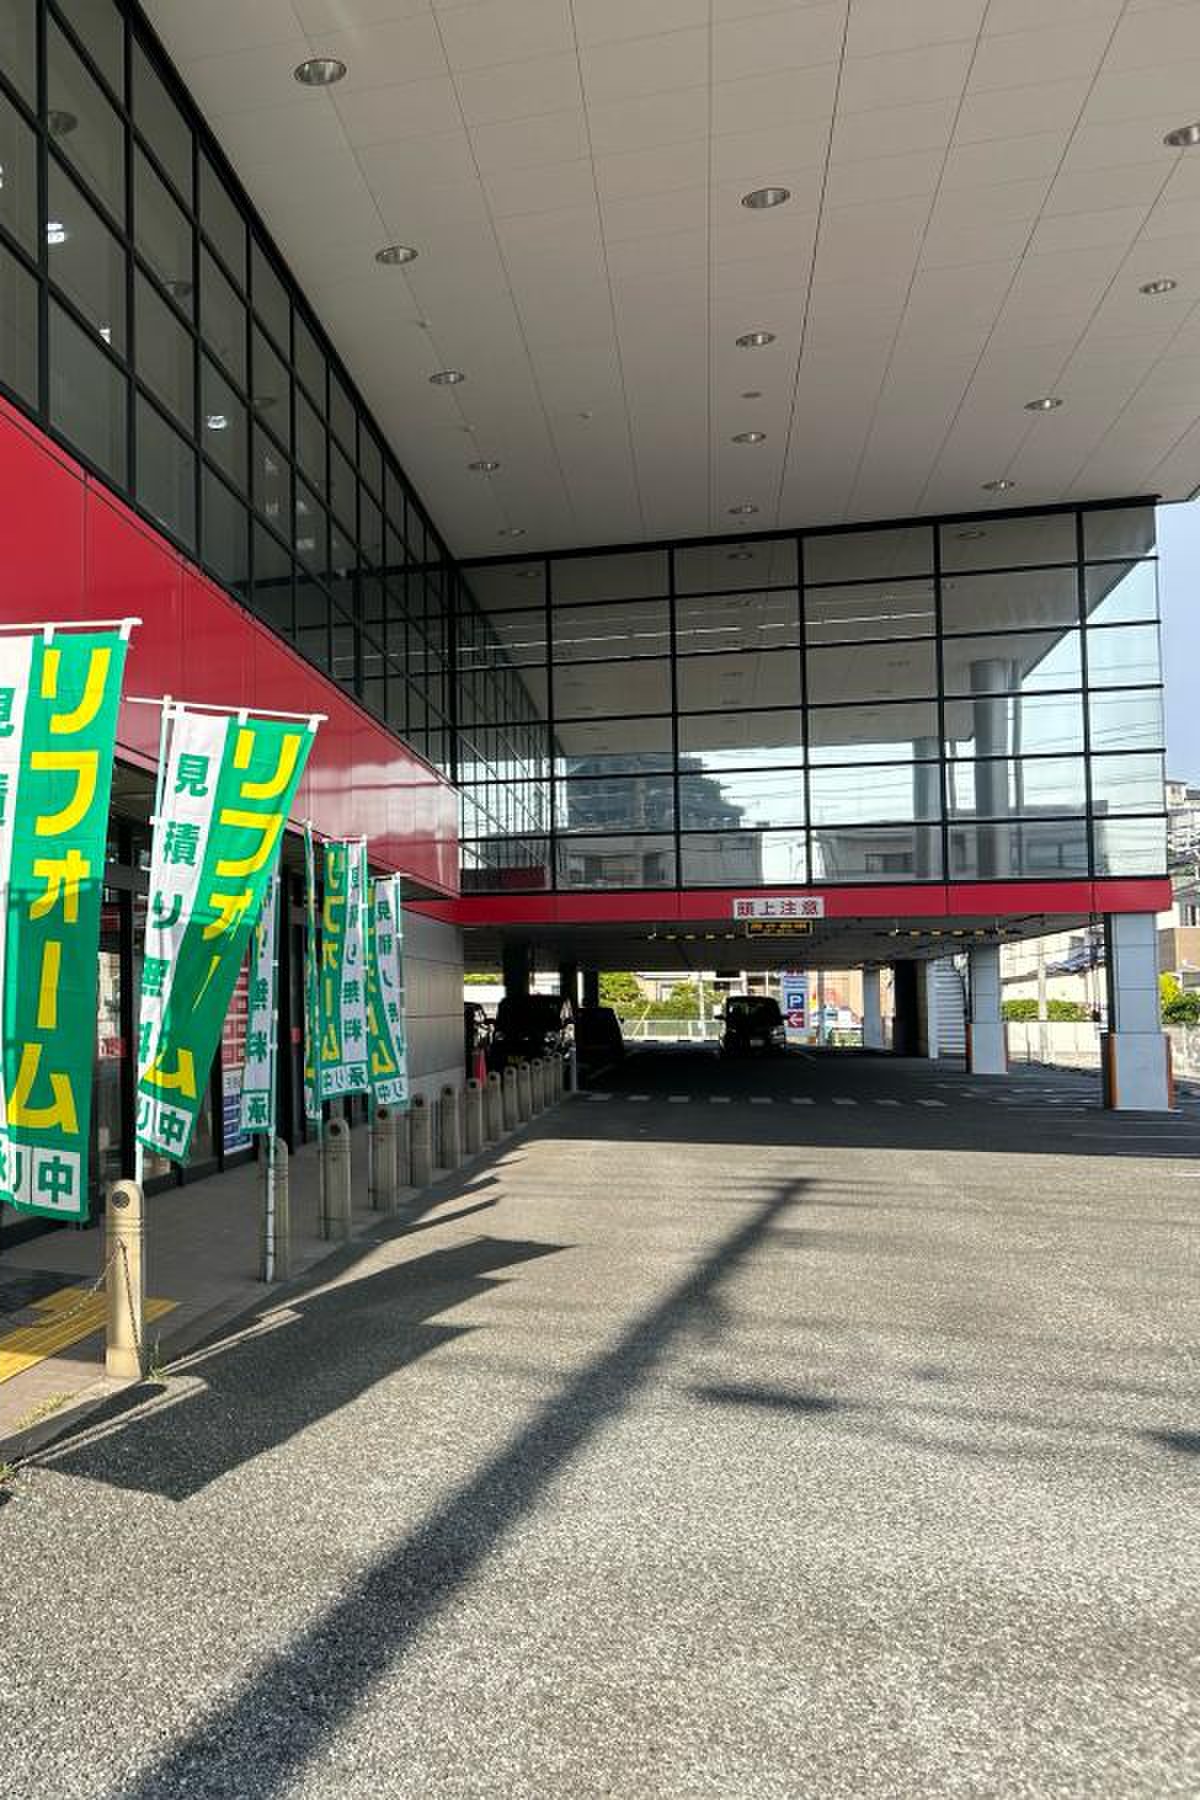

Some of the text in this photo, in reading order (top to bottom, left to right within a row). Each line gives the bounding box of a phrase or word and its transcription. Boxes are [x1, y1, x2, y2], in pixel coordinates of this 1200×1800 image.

[7, 646, 112, 1135] リフォーム
[143, 728, 302, 1099] リフォム
